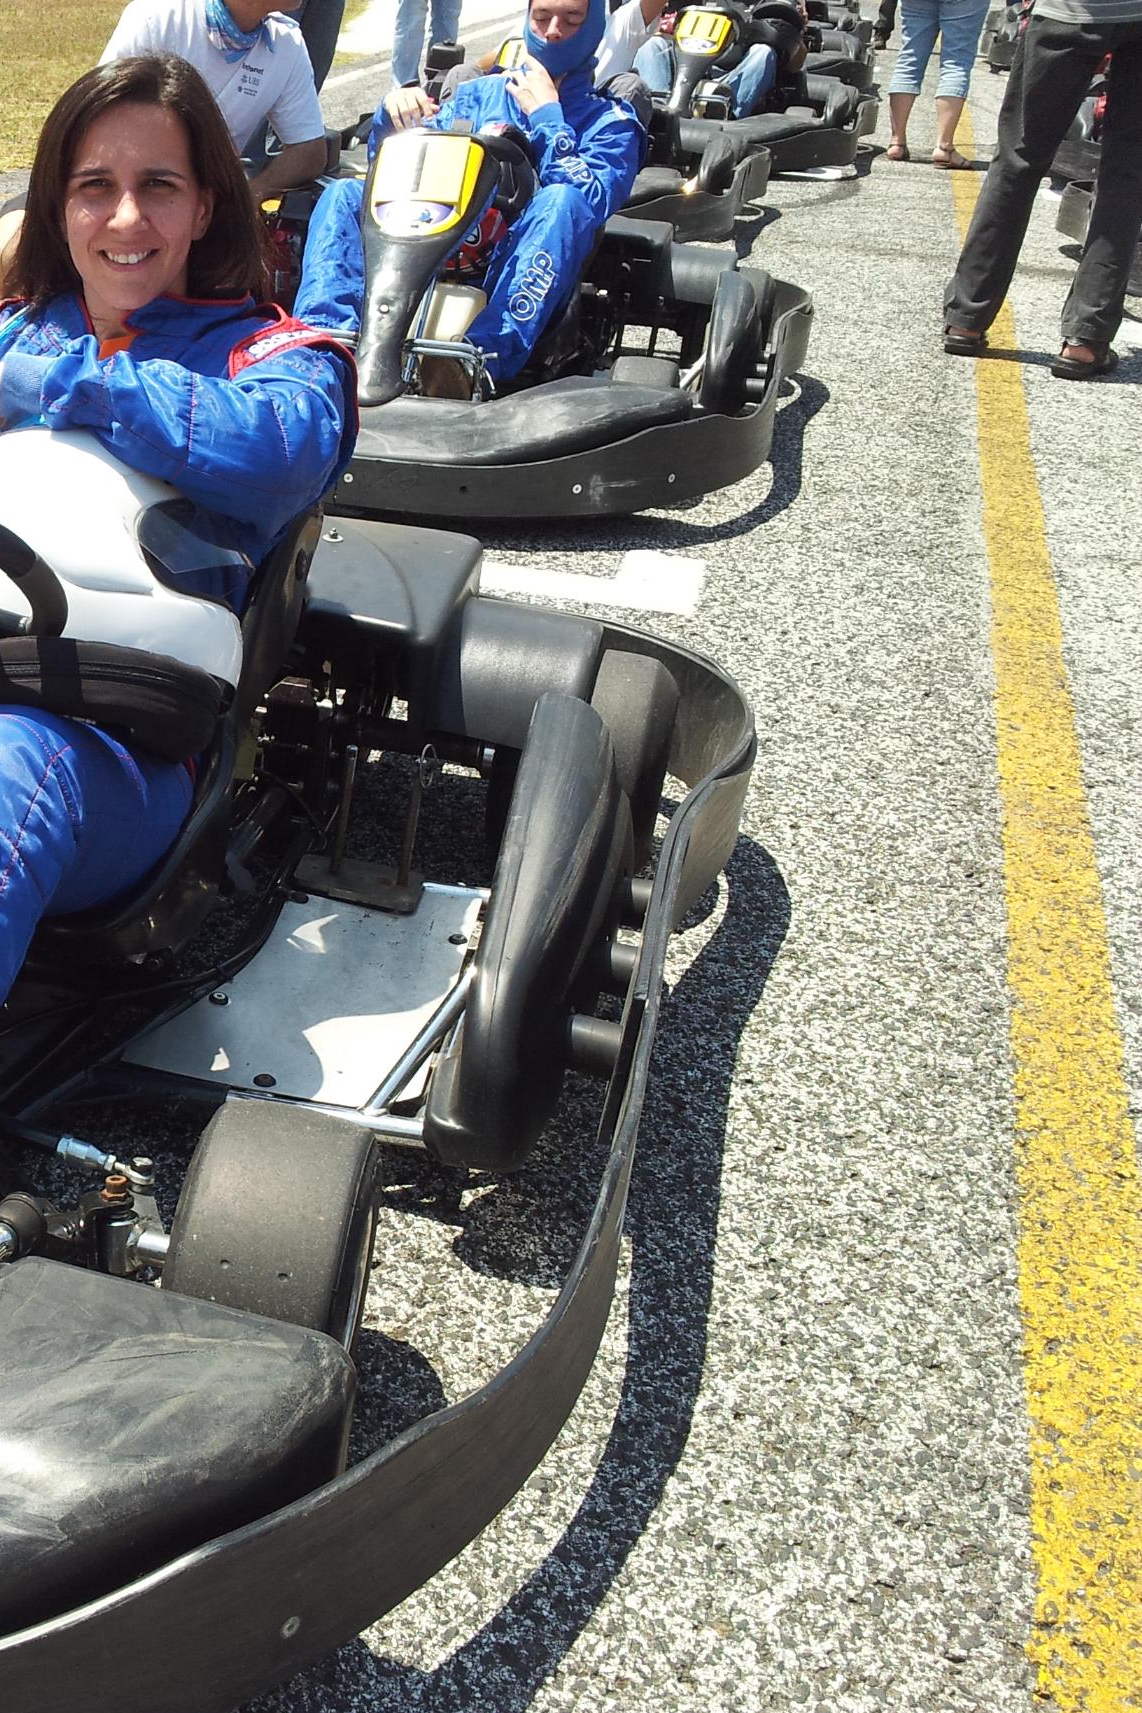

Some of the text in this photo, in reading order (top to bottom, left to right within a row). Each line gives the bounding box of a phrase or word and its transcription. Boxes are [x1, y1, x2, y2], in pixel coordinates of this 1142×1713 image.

[689, 15, 719, 38] 11
[411, 141, 429, 193] 1
[553, 131, 594, 182] OMP
[509, 251, 556, 321] OMP
